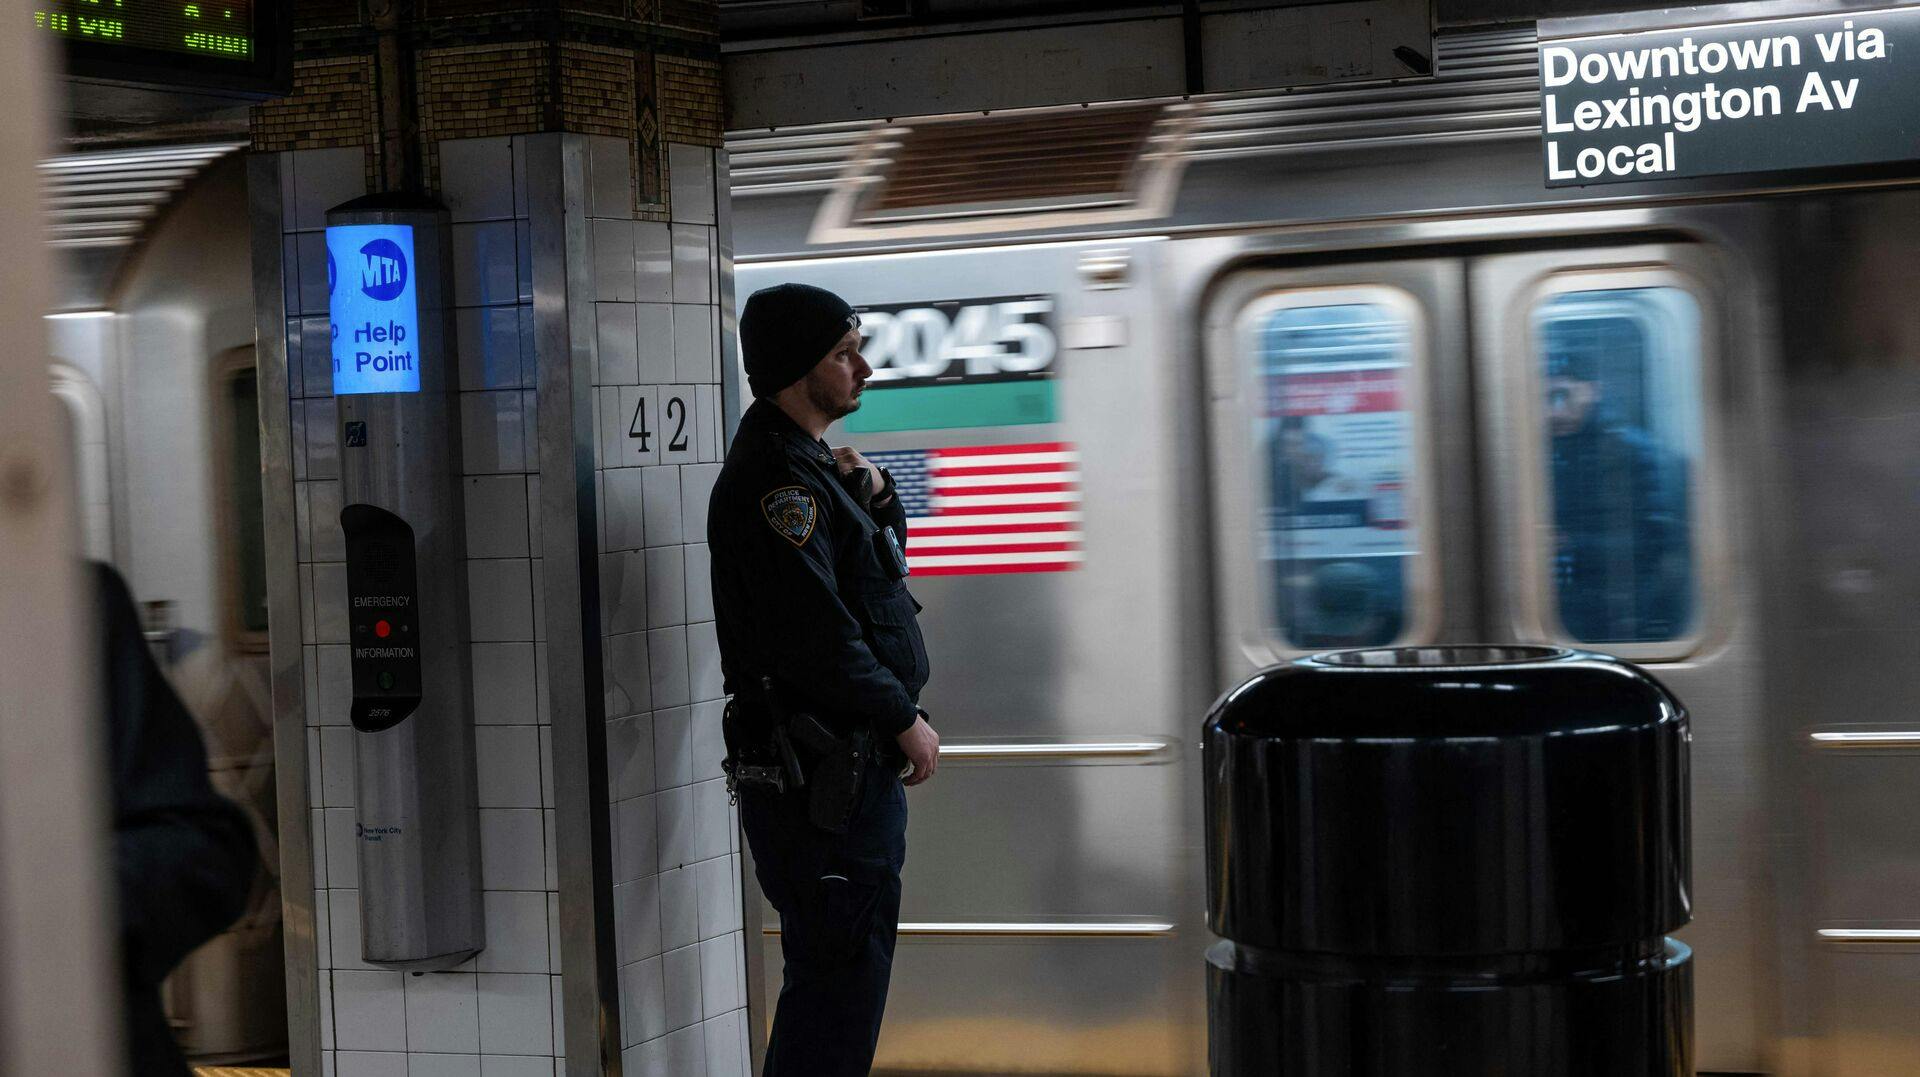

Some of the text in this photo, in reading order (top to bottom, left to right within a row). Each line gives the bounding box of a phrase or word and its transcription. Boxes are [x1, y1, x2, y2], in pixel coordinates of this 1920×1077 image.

[1543, 20, 1887, 88] Downtown via
[1545, 71, 1860, 133] Lexington Av
[1547, 132, 1676, 180] Local
[361, 253, 401, 289] MTA
[354, 319, 406, 346] Help
[856, 300, 1057, 382] 2045
[355, 350, 413, 373] Point
[767, 495, 811, 512] DEPARTMENT
[774, 489, 800, 501] POLICE
[354, 596, 411, 608] EMERGENCY
[355, 646, 414, 659] INFORMATION
